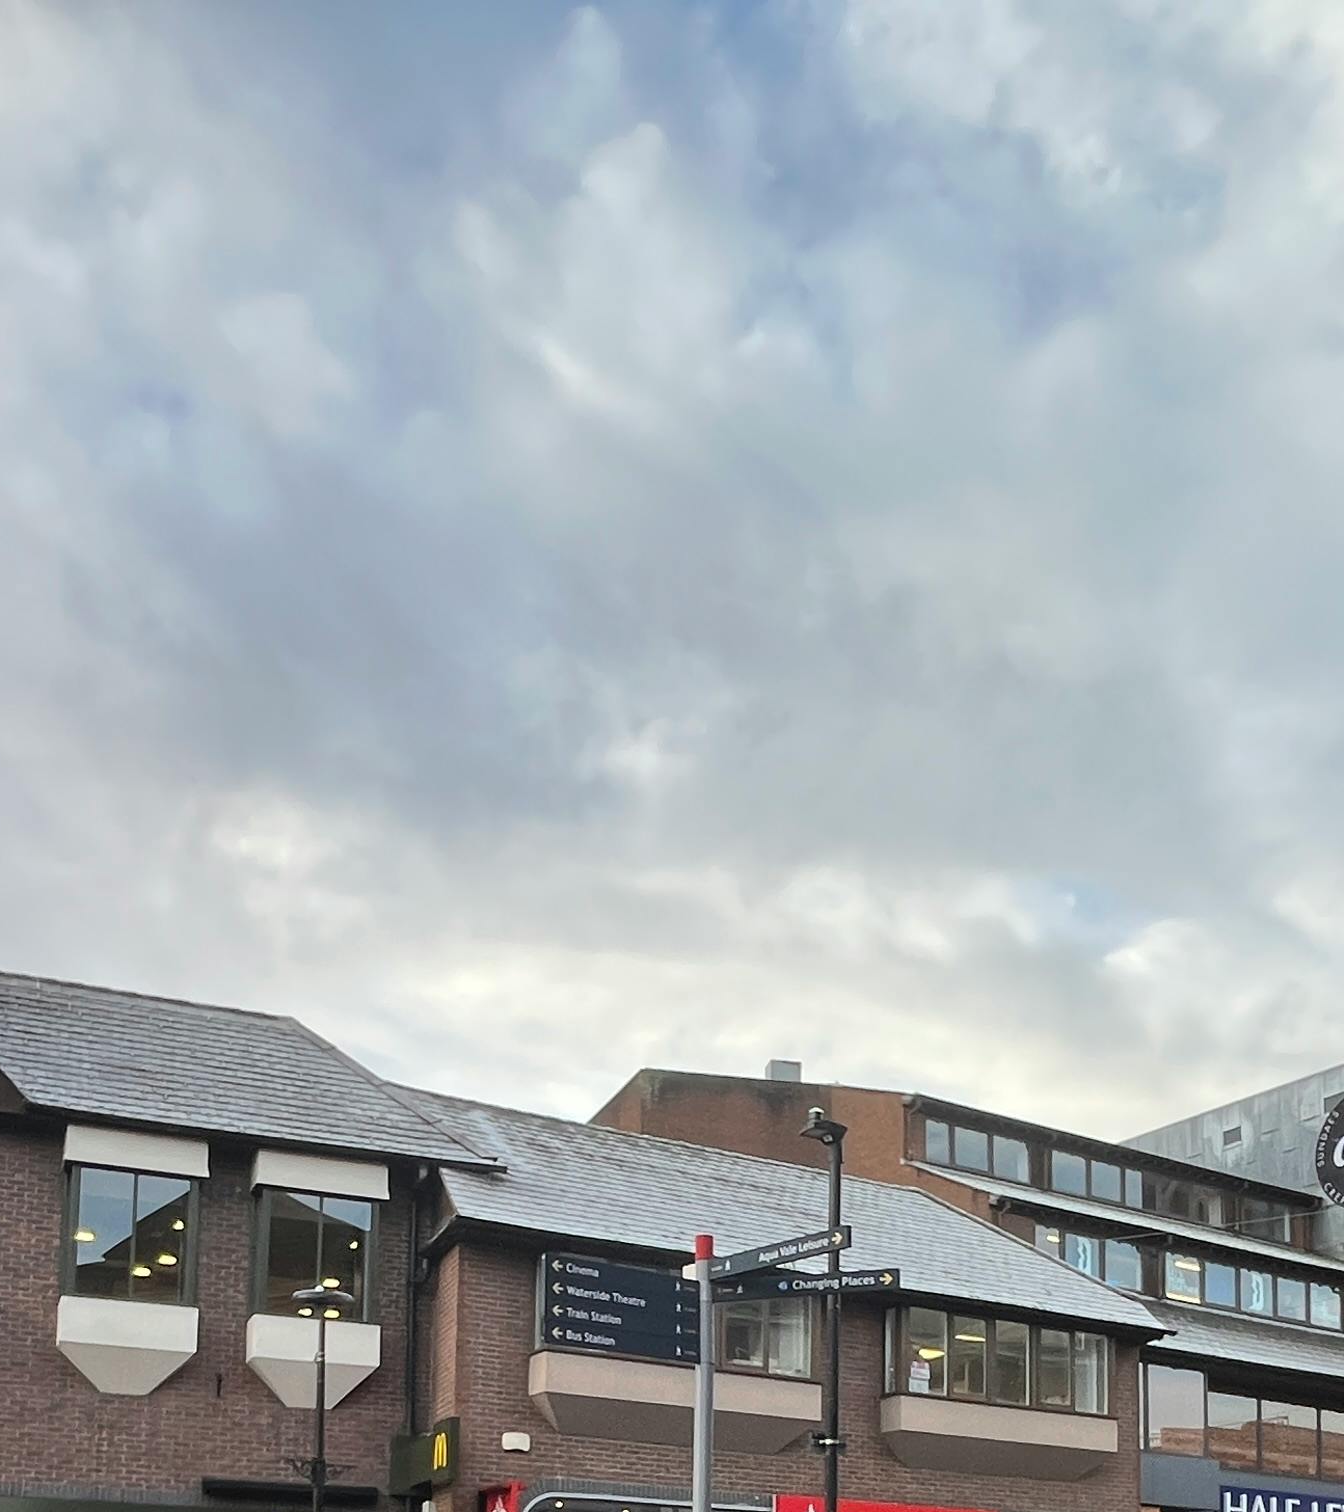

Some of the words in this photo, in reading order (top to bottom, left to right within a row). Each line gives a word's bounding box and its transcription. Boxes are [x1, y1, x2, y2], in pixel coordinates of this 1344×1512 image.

[1316, 1111, 1340, 1168] SUNDAES
[758, 1249, 779, 1263] Aqua
[798, 1237, 830, 1252] Leisure
[565, 1262, 600, 1278] Cinema
[792, 1277, 840, 1291] Changing
[841, 1275, 875, 1287] Places
[566, 1285, 611, 1303] Waterside
[612, 1292, 647, 1308] Theatre
[567, 1307, 589, 1321] Train
[590, 1311, 622, 1325] Station
[566, 1329, 583, 1341] Bus
[584, 1332, 616, 1346] Station
